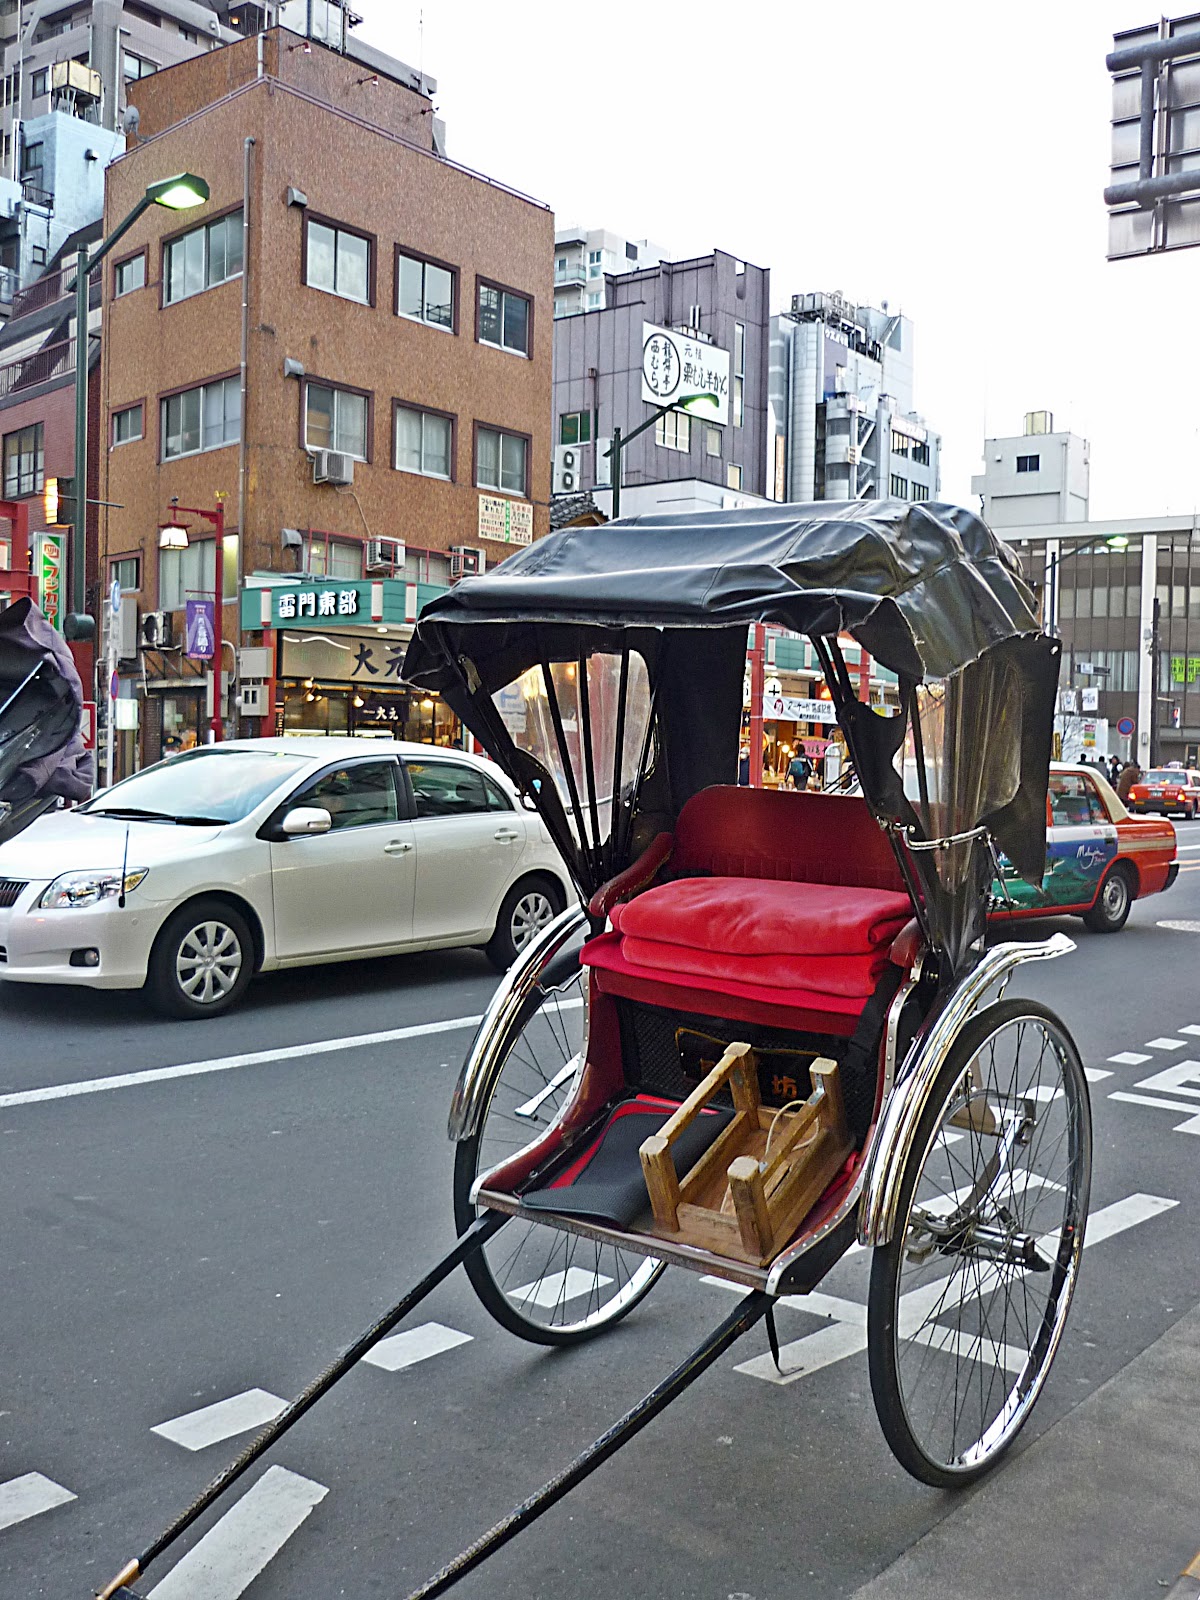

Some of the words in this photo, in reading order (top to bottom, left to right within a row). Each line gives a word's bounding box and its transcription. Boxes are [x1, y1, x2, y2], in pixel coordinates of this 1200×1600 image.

[650, 340, 660, 389] 西むら
[683, 362, 728, 396] 栗むし羊かん
[279, 589, 358, 618] 雷門東部
